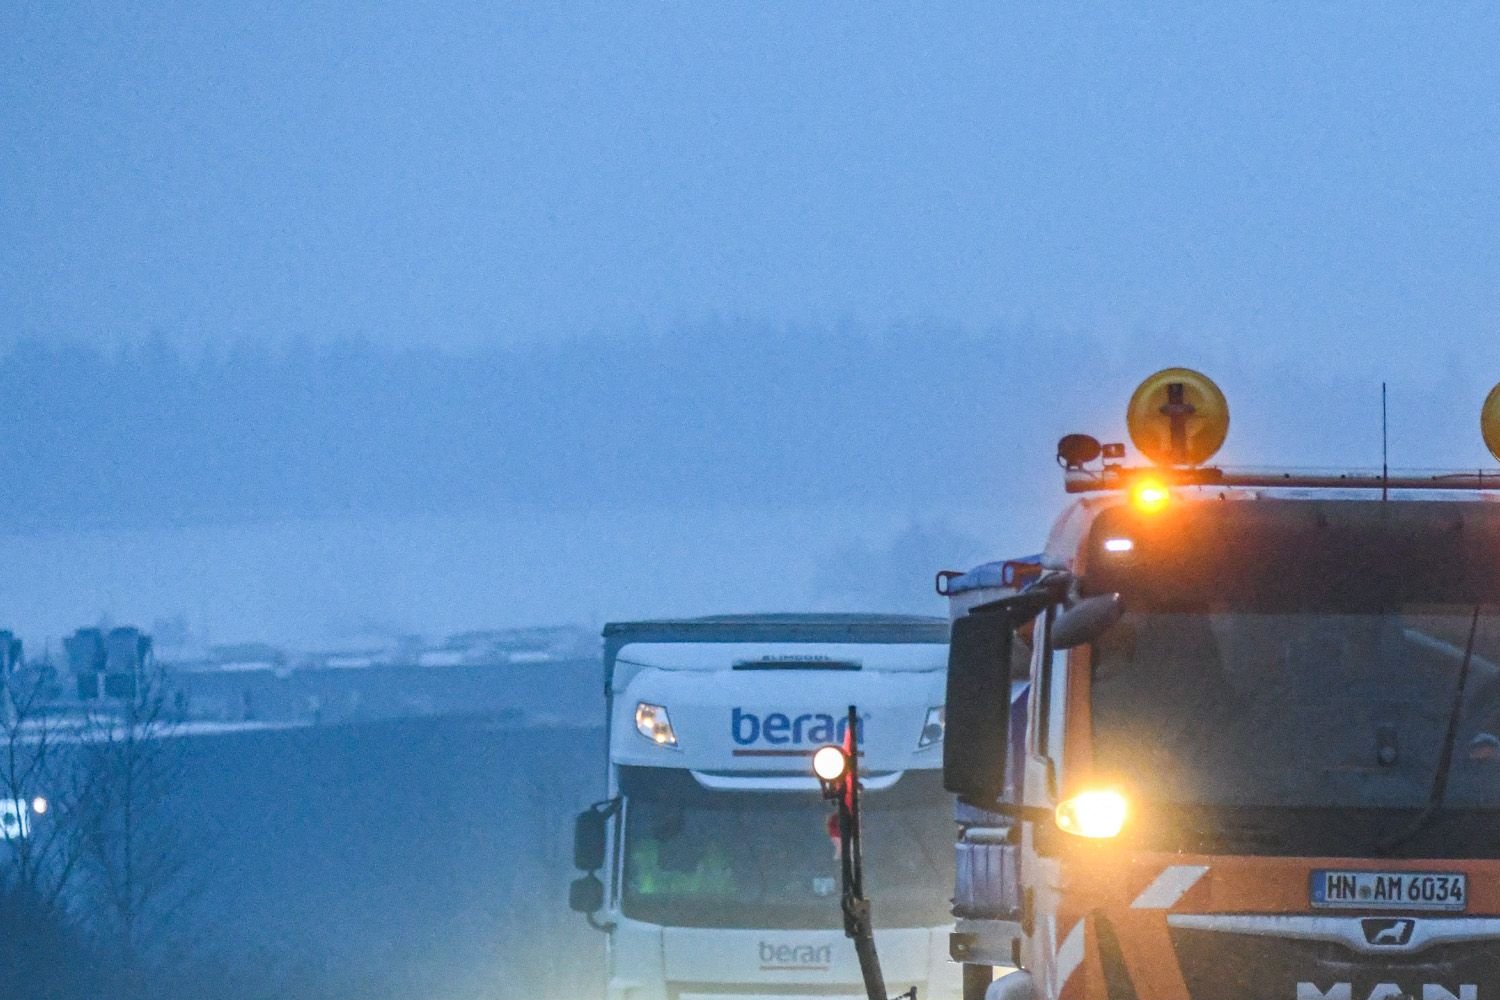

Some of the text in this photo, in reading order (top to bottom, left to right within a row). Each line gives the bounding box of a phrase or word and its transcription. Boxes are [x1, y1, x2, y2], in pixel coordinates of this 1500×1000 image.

[732, 707, 864, 745] beran
[1327, 875, 1356, 899] HN
[1374, 876, 1402, 901] AM
[1408, 877, 1462, 901] 6034
[759, 941, 831, 962] beran
